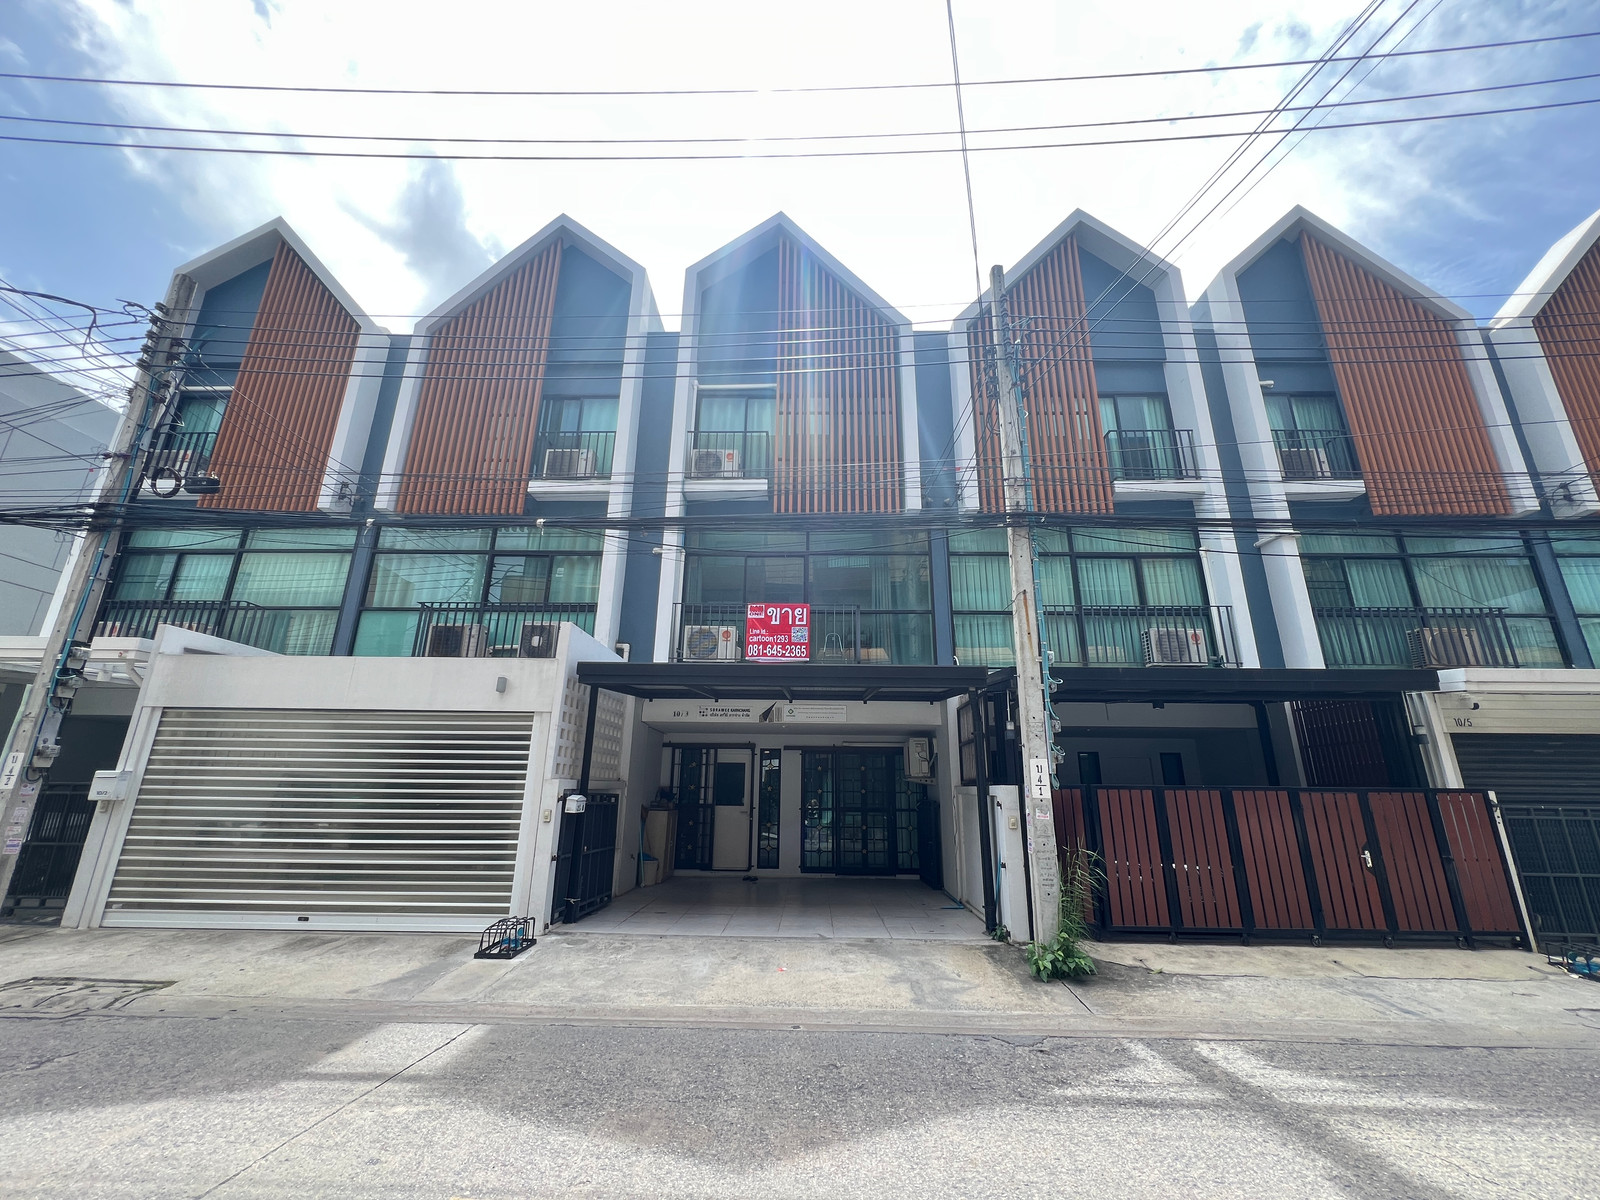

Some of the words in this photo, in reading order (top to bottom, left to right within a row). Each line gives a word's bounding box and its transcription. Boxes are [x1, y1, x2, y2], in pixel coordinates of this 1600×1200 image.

[766, 607, 806, 625] ขาย
[748, 644, 806, 656] 081-645-2365
[1453, 718, 1472, 727] 10/5
[1038, 775, 1042, 784] 4
[1038, 786, 1043, 796] 1
